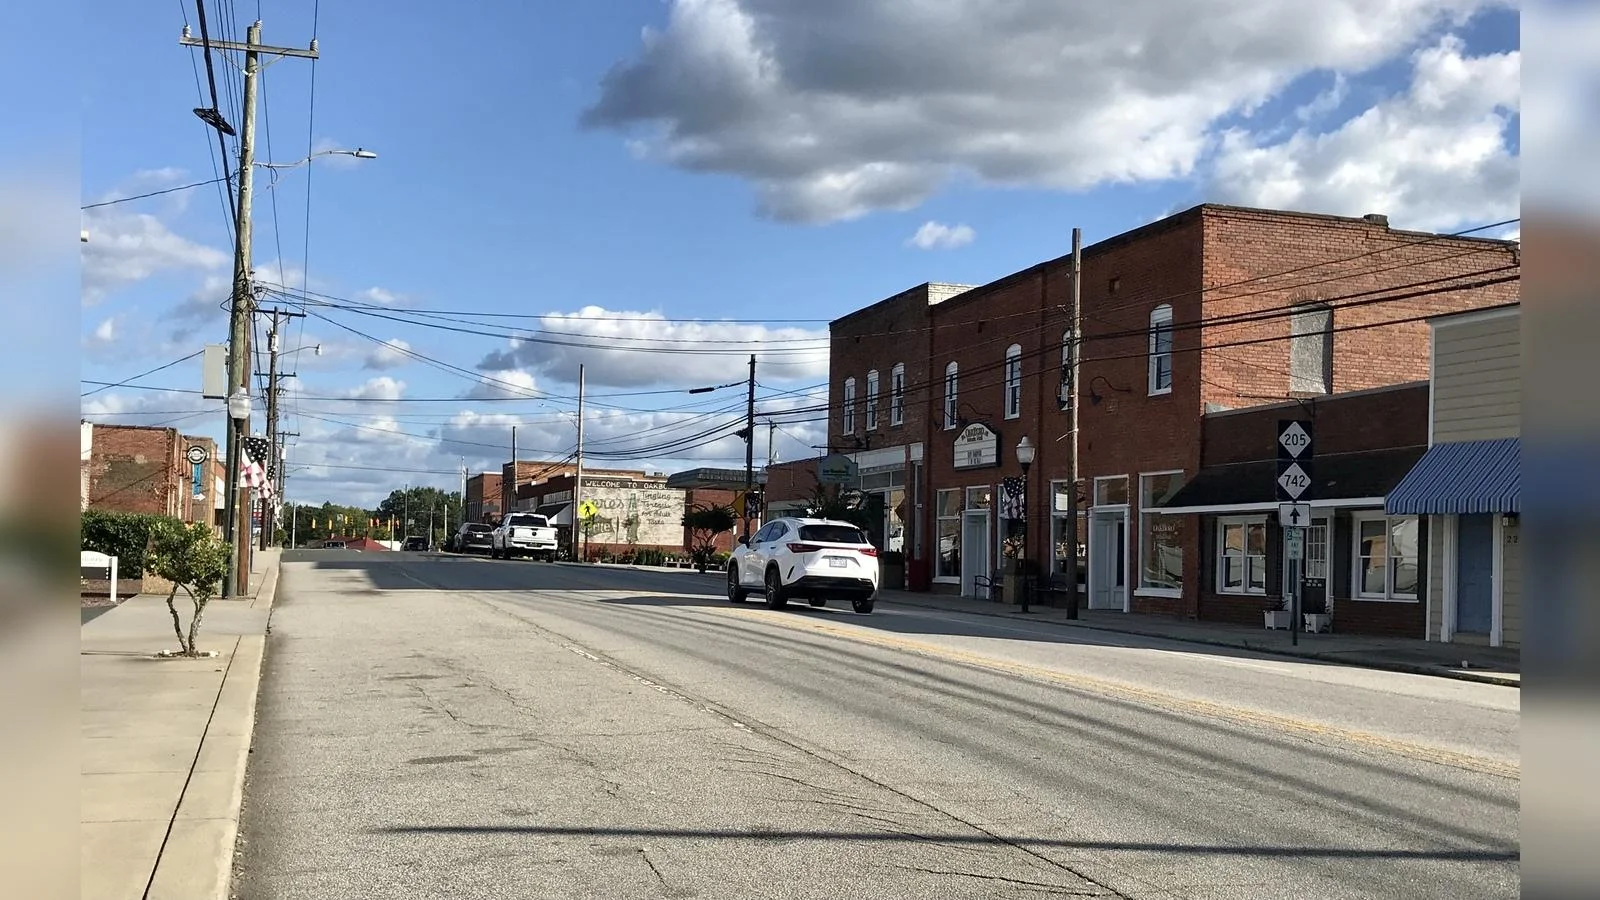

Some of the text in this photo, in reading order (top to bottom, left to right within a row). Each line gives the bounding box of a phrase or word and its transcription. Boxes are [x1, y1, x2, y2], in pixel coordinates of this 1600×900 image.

[1284, 433, 1306, 446] 205
[585, 480, 620, 488] WELCOME
[1284, 474, 1306, 488] 742
